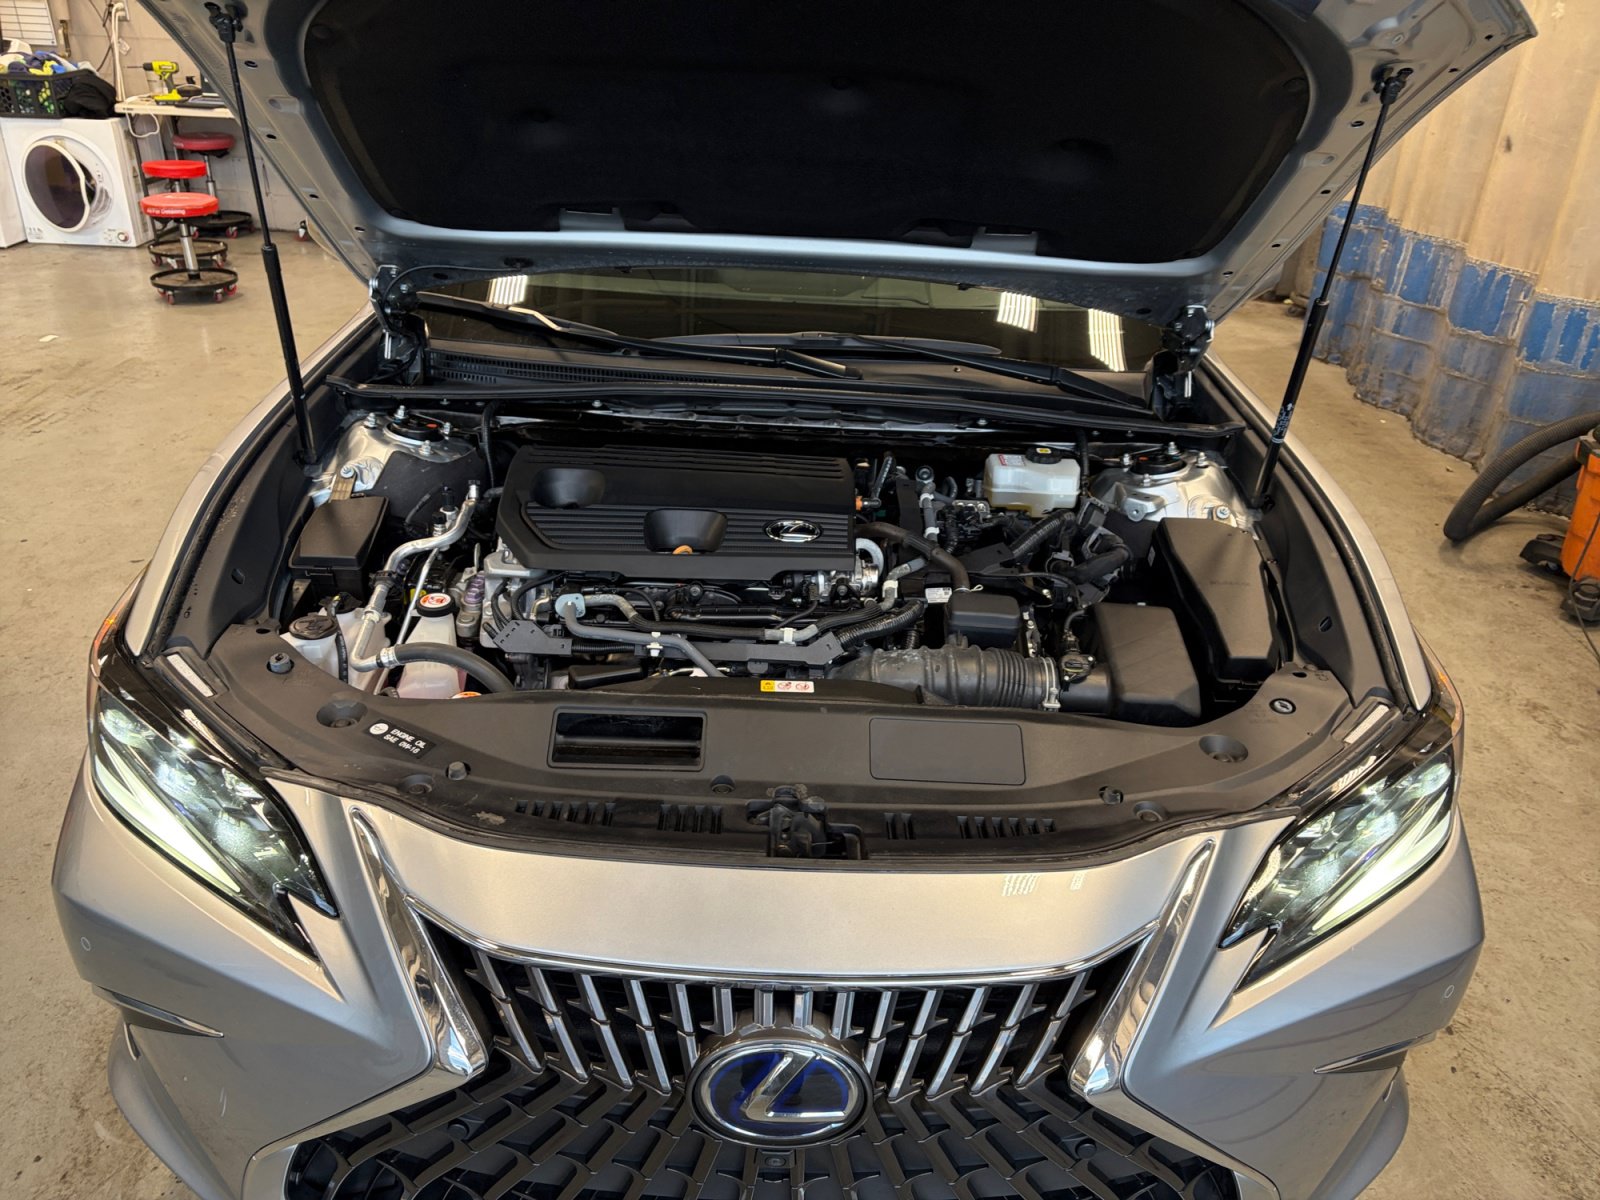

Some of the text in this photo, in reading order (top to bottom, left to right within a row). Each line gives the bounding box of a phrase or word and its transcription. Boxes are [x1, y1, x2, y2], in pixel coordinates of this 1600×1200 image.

[383, 733, 400, 744] SAE
[390, 728, 427, 749] ENGINE OIL
